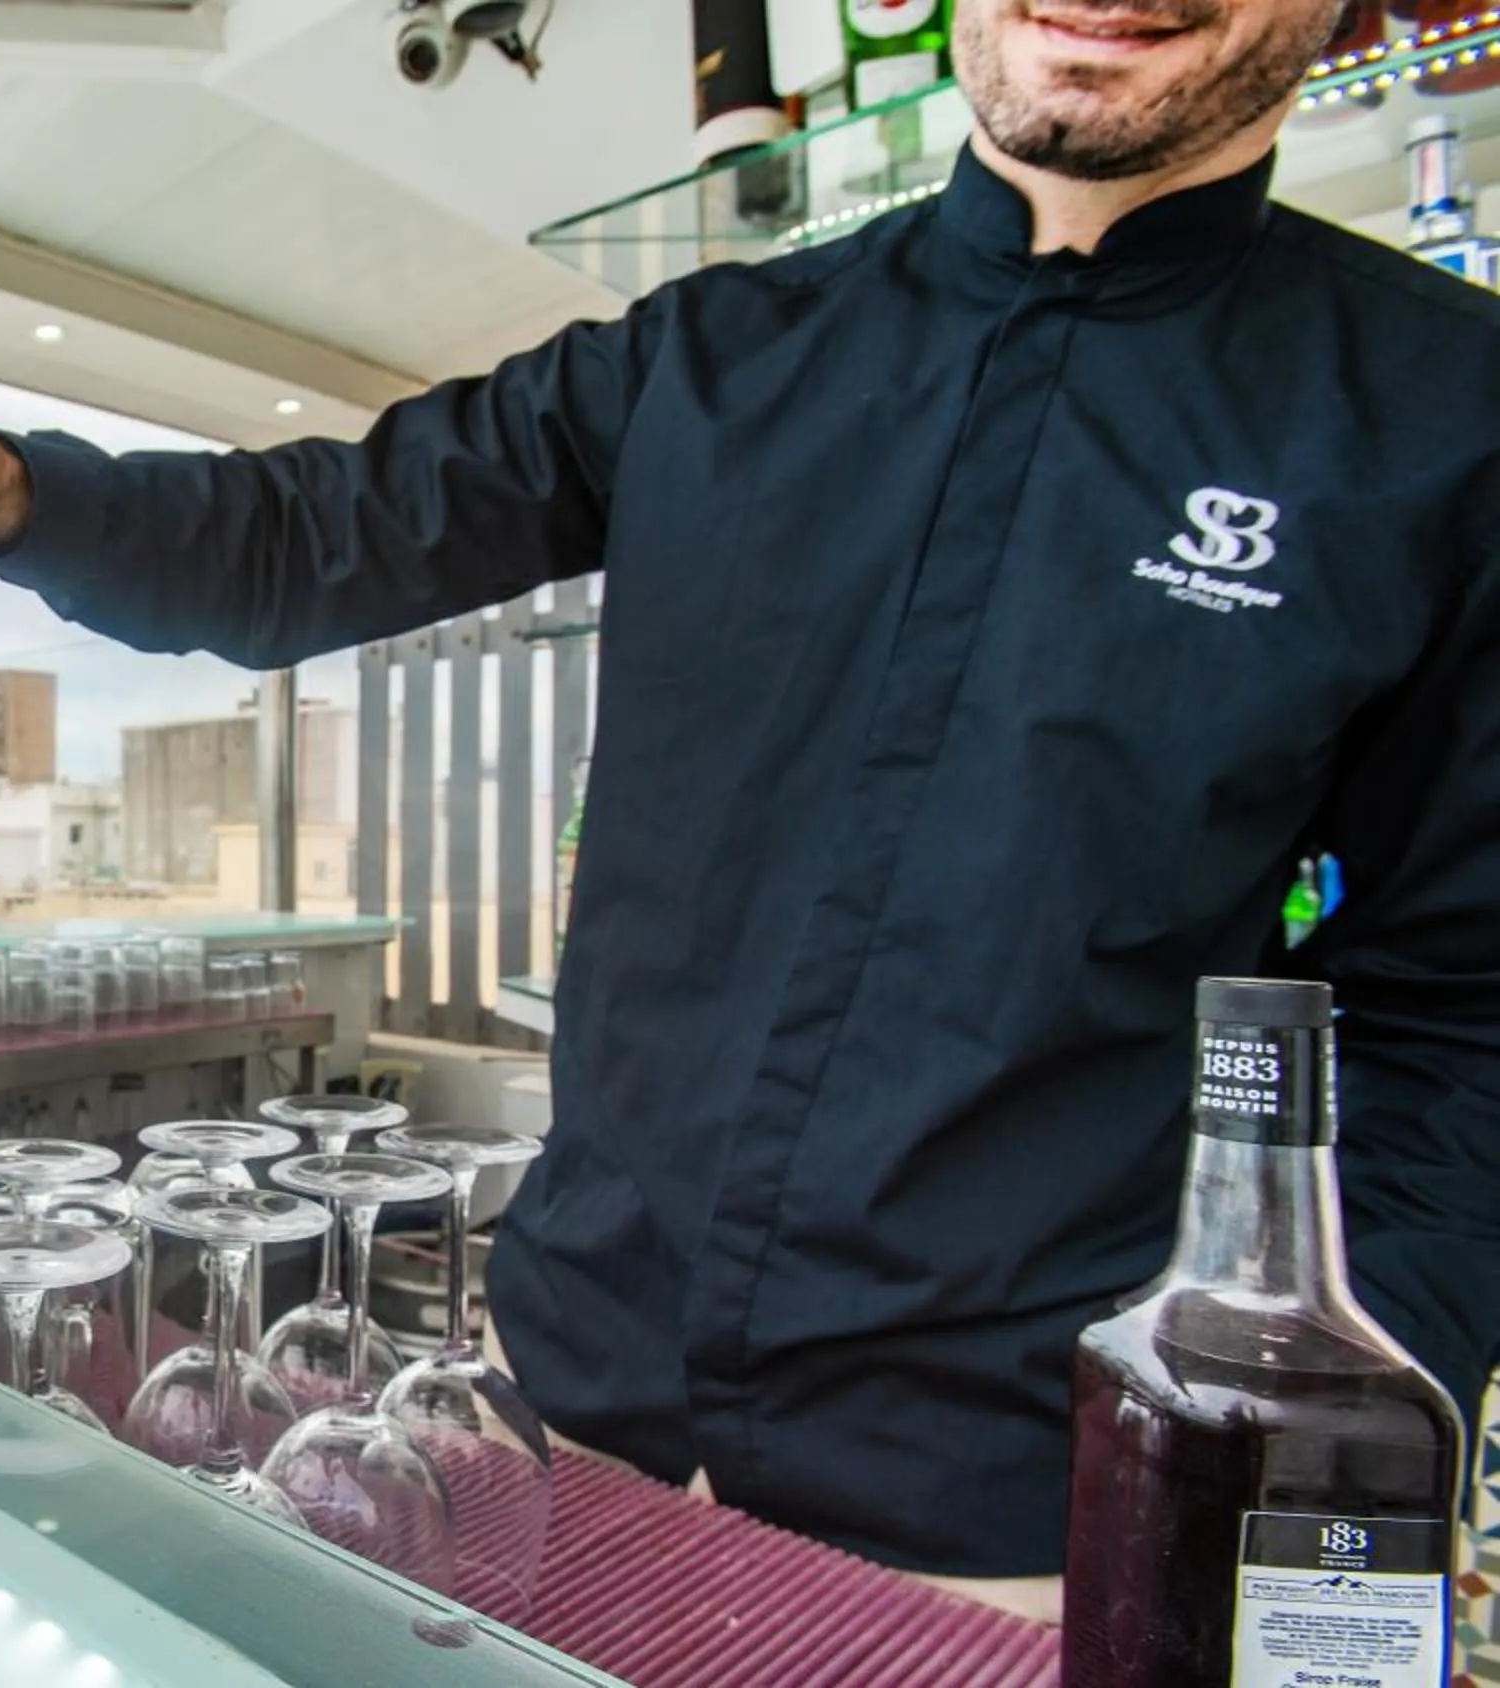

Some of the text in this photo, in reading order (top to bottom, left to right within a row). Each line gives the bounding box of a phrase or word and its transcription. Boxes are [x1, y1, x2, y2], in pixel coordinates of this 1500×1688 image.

[1203, 1037, 1279, 1055] DEPUIS
[1201, 1052, 1281, 1083] 1883
[1201, 1083, 1278, 1102] MAISON
